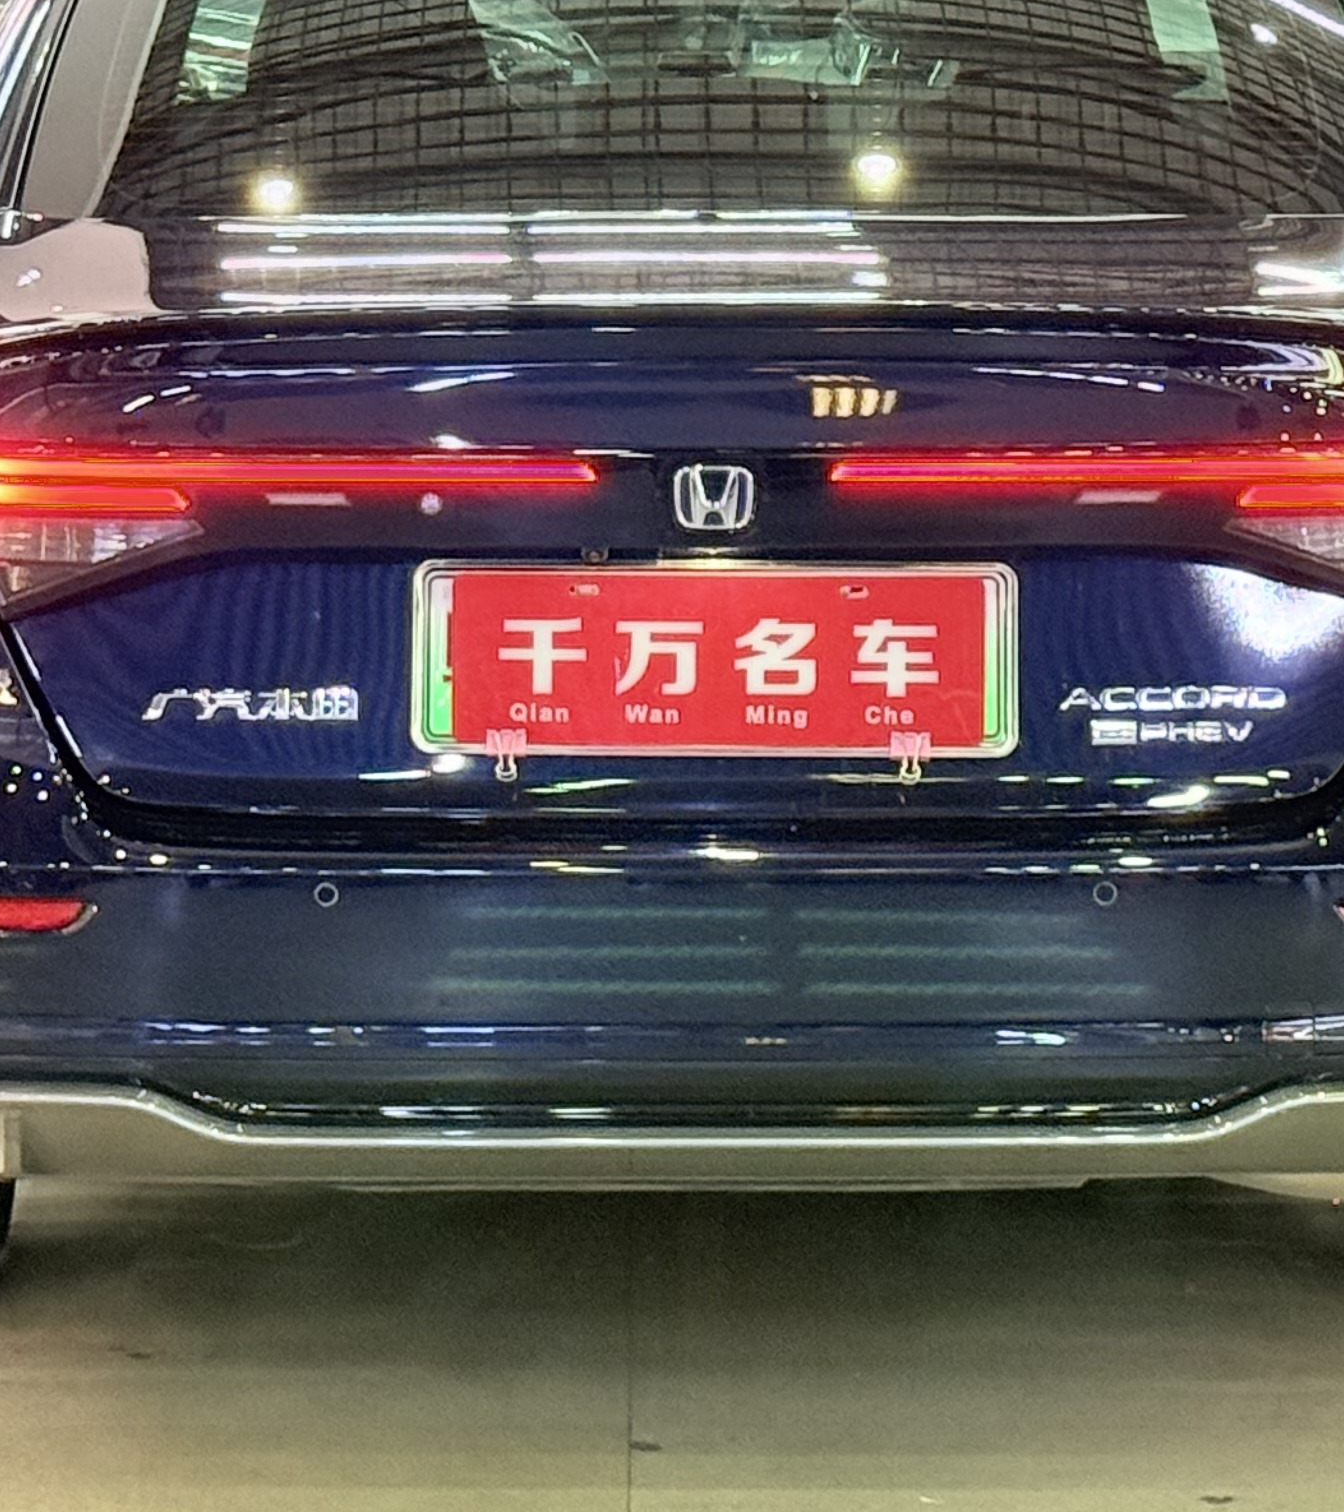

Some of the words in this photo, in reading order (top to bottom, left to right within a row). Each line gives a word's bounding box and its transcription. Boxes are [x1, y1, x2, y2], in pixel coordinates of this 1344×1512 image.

[497, 617, 940, 698] 千万名车
[141, 687, 359, 721] 广汽本田
[1059, 685, 1288, 712] ACCORD
[509, 703, 570, 724] Qian
[624, 703, 680, 724] Wan
[744, 704, 809, 730] Ming
[864, 705, 915, 726] Che
